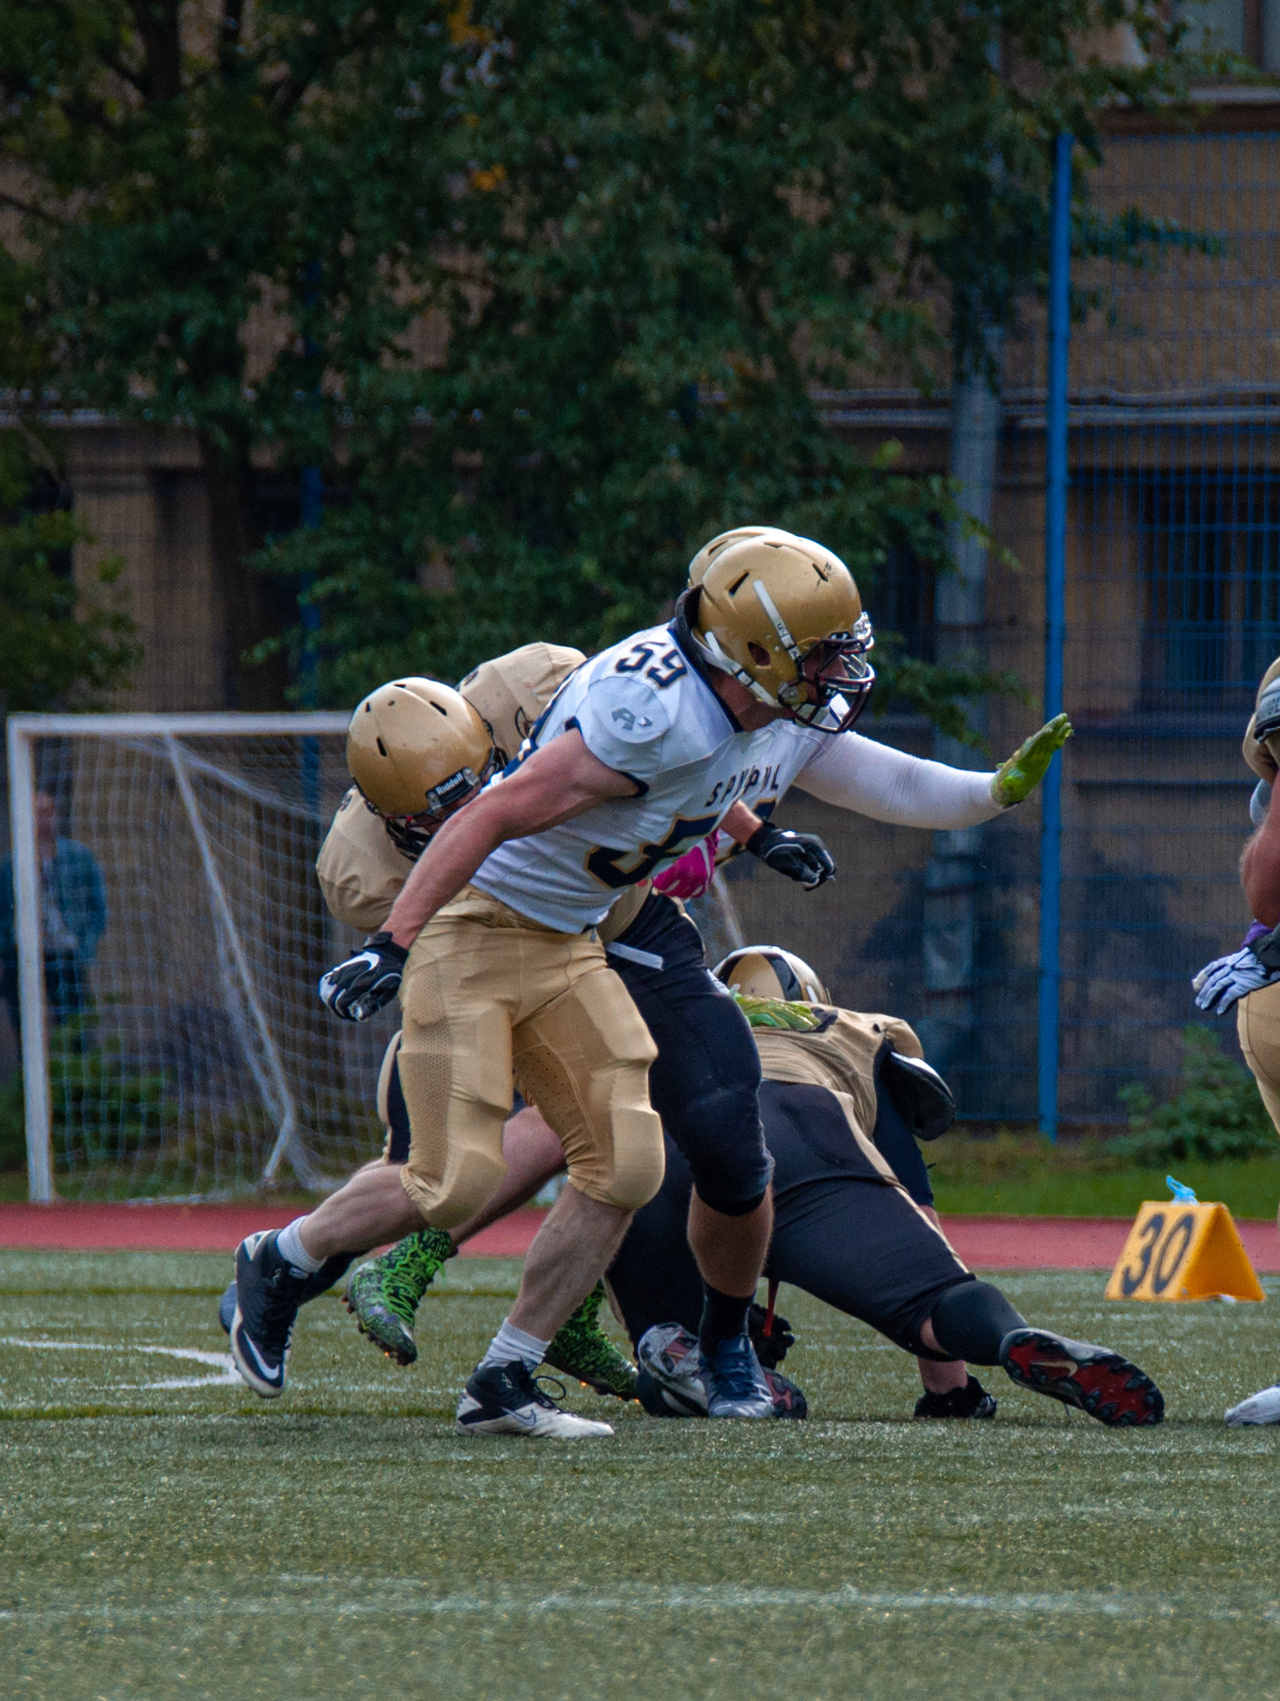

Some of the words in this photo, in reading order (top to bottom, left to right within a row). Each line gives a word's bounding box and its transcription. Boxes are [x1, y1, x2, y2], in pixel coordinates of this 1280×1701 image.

[614, 641, 689, 690] 59
[434, 772, 464, 796] Riddell
[1119, 1212, 1196, 1297] 30
